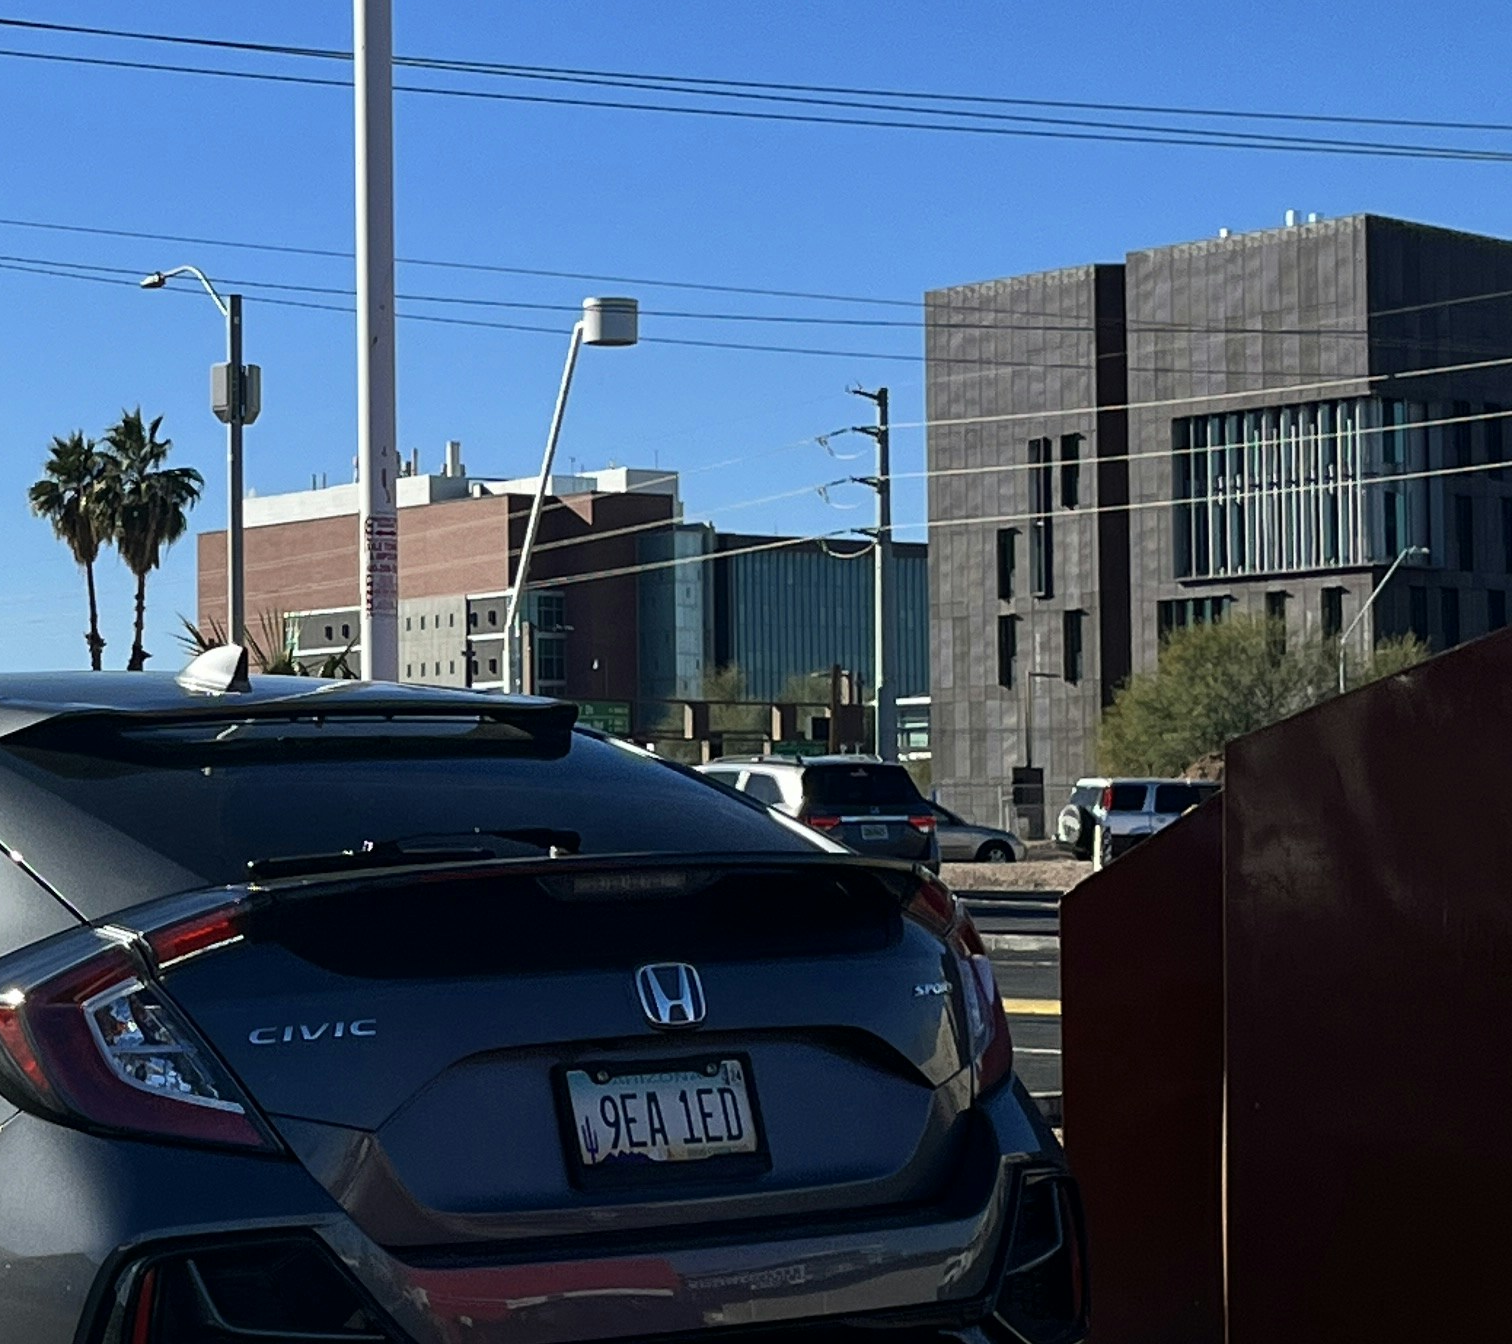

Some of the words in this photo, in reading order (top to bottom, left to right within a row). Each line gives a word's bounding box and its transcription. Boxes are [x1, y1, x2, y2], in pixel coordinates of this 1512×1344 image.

[914, 981, 953, 996] SPOR
[248, 1018, 377, 1045] CIVIC
[600, 1091, 669, 1150] 9EA
[679, 1087, 744, 1144] 1ED
